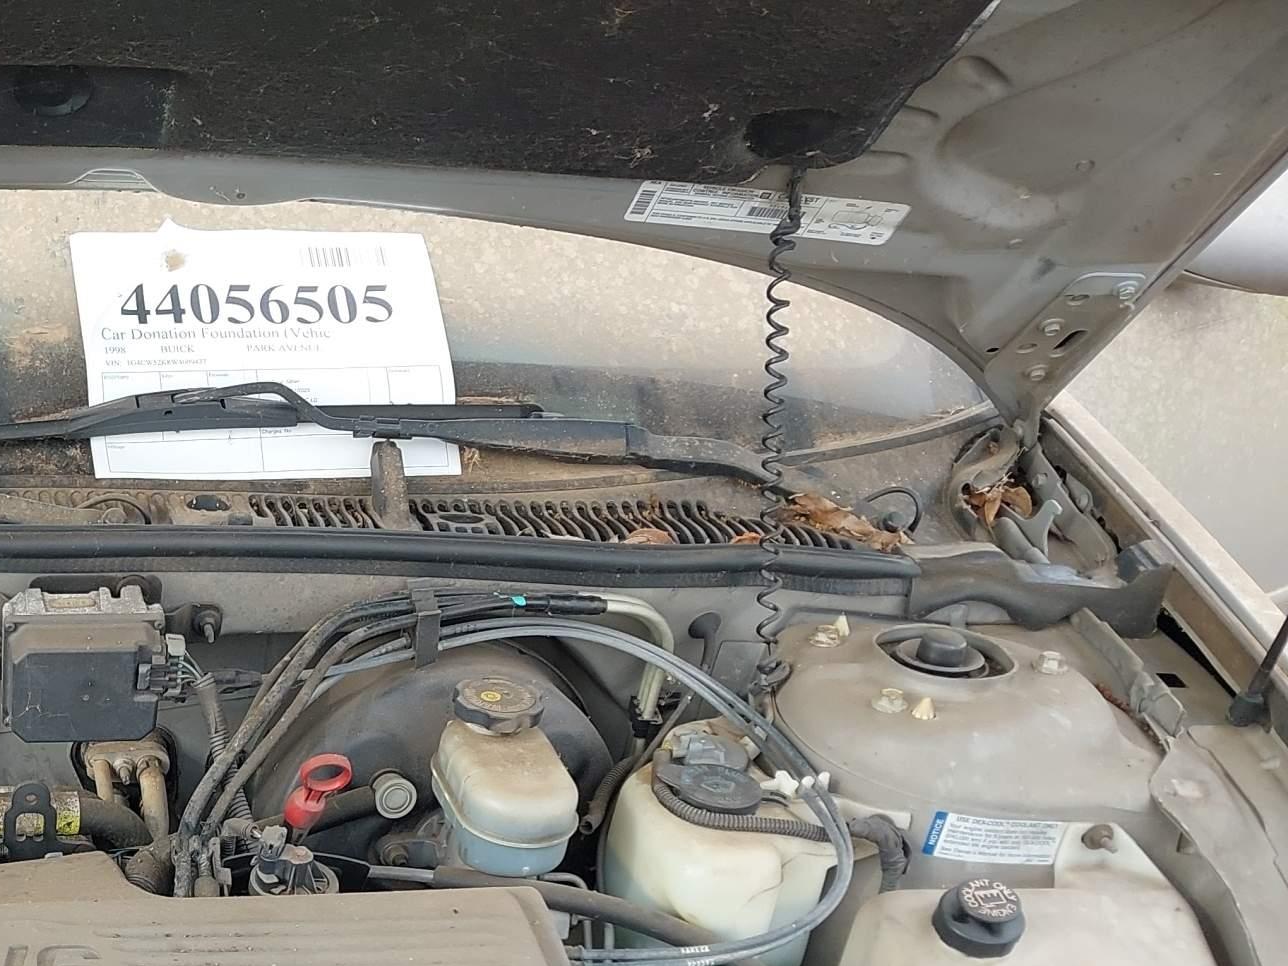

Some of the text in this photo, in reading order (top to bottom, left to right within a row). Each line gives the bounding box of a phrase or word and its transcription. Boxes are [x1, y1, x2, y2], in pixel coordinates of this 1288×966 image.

[121, 283, 393, 325] 44056505
[101, 327, 125, 341] Car
[132, 327, 195, 340] Donation
[201, 326, 280, 340] Foundation
[104, 346, 126, 355] 1998
[161, 344, 195, 353] BUICK
[247, 344, 275, 352] PARK
[928, 818, 944, 846] NOTICE
[961, 879, 1017, 907] COOLANT ONLY
